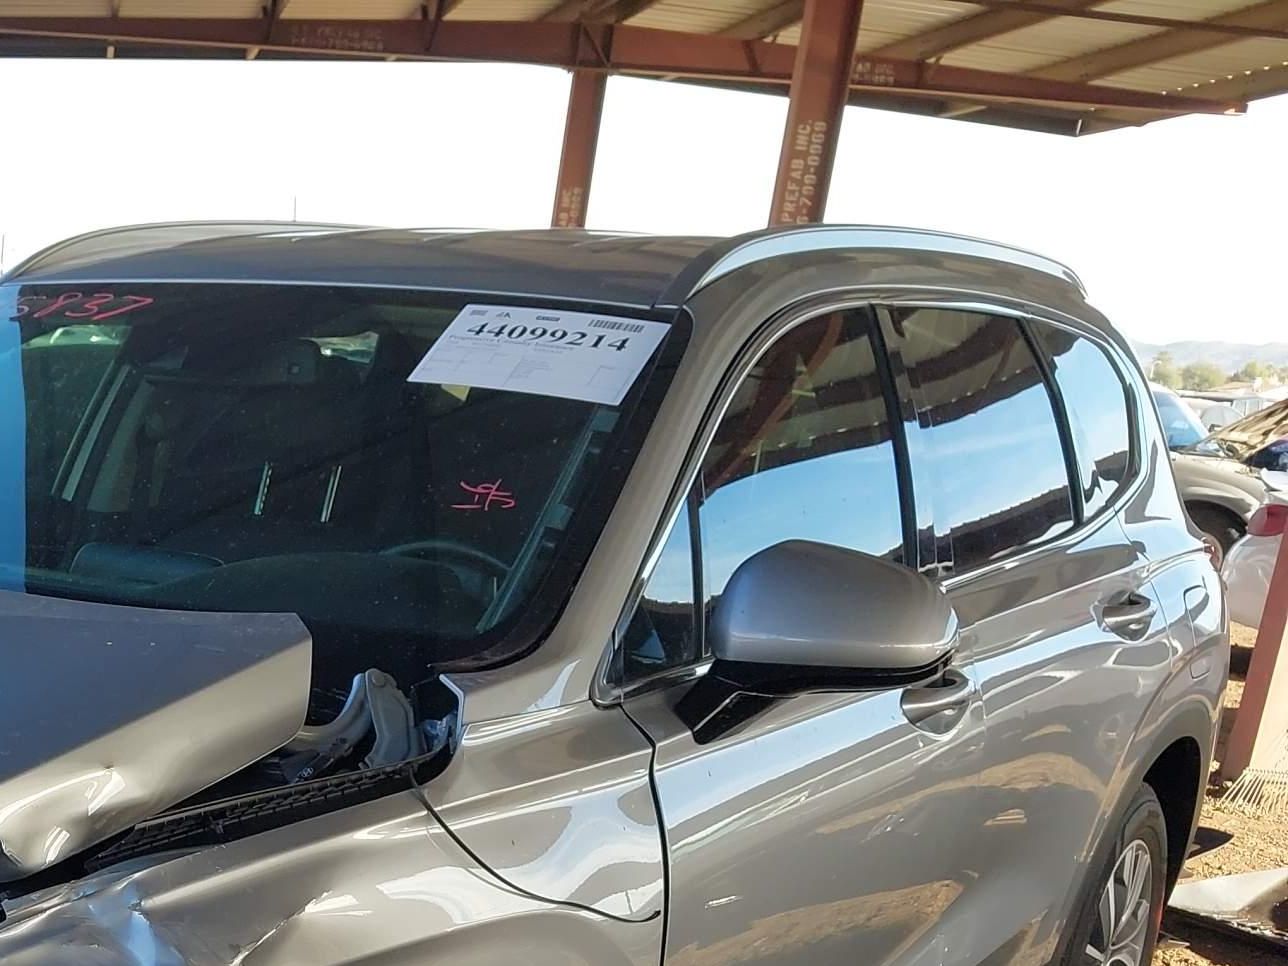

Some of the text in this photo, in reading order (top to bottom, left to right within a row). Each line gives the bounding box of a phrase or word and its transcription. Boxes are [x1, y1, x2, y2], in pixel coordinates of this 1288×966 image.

[781, 120, 813, 222] PREFAB INC.
[466, 321, 630, 351] 44099214
